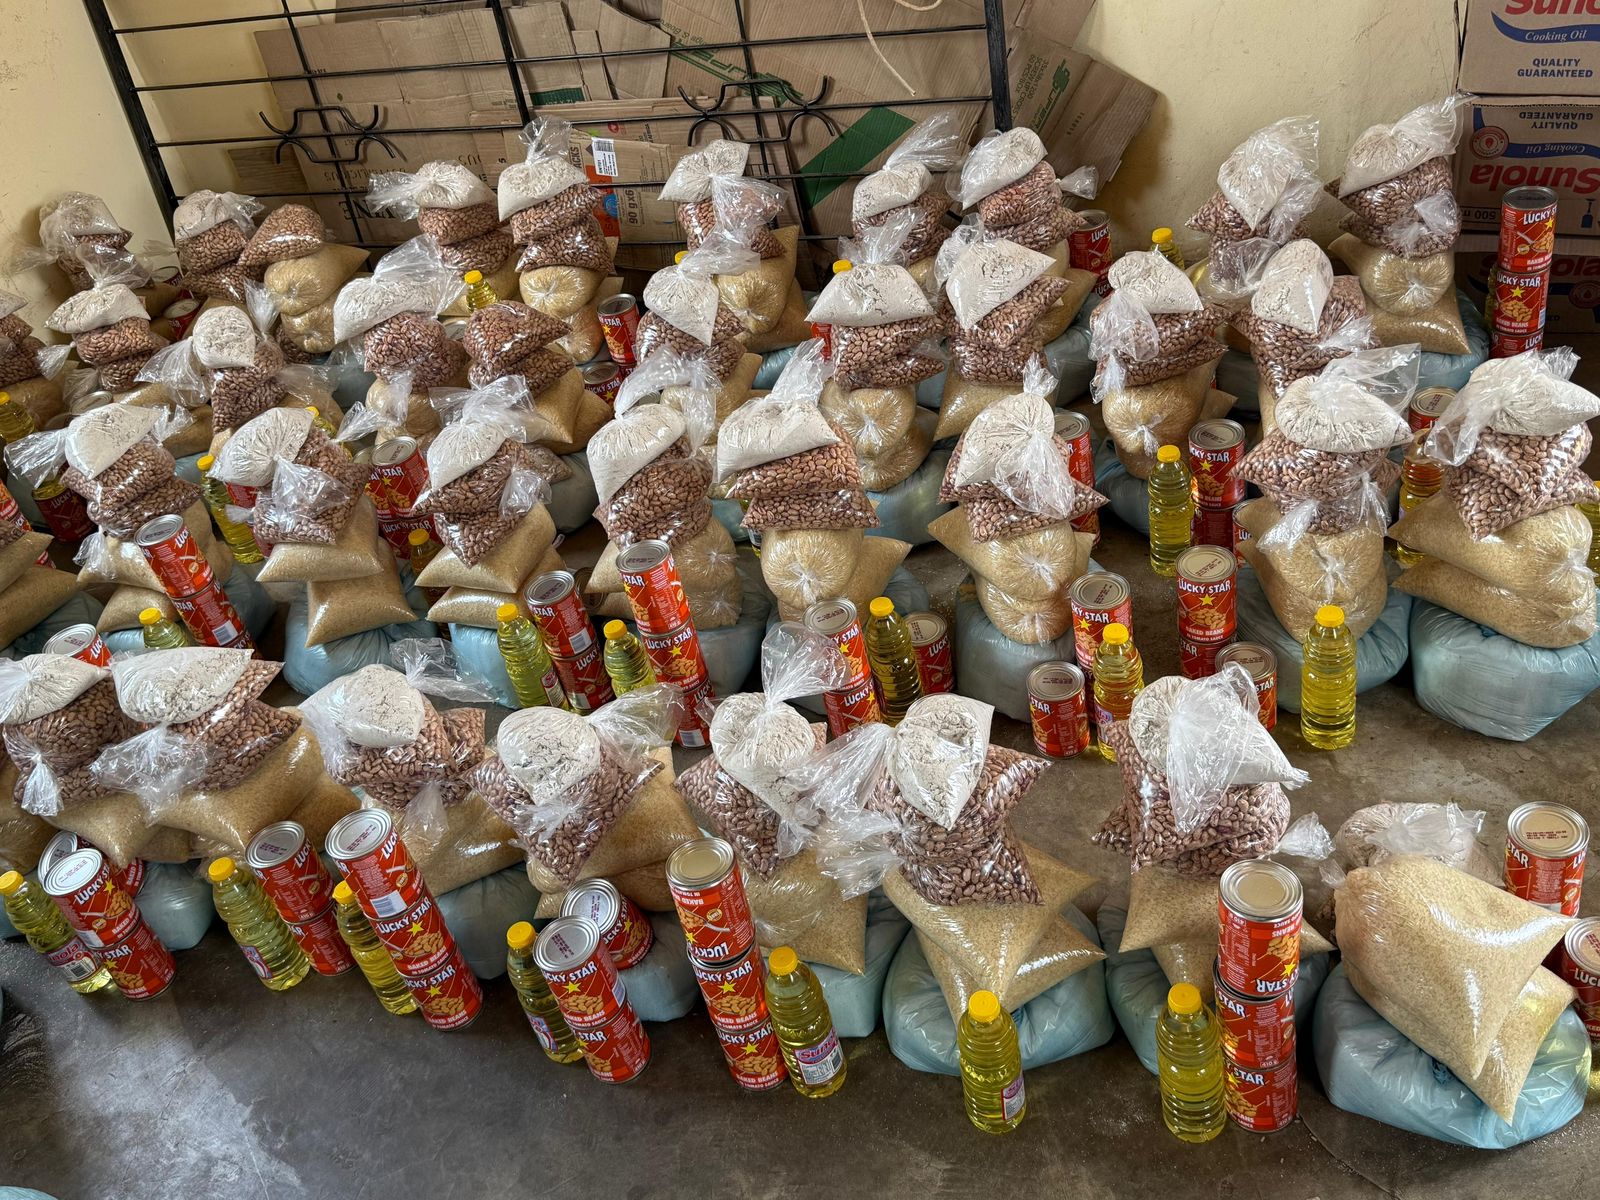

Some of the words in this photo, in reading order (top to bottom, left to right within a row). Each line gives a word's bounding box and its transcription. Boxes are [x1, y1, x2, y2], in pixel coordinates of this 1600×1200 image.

[1525, 32, 1567, 42] Cooking
[1570, 30, 1587, 40] Oil
[1533, 58, 1580, 67] QUALITY
[1517, 69, 1593, 78] GUARANTEED
[1519, 112, 1593, 121] GUARANTEED
[1531, 121, 1578, 130] QUALITY
[1526, 146, 1541, 154] Oil
[1545, 144, 1586, 153] Cooking
[570, 147, 582, 168] ACKS
[1470, 165, 1600, 194] Sunola
[1475, 210, 1496, 219] 500
[1523, 209, 1550, 225] LUCKY
[1520, 276, 1541, 287] STAR
[604, 318, 622, 327] STAR
[1207, 452, 1231, 463] STAR
[382, 466, 404, 476] STAR
[411, 521, 432, 530] STAR
[623, 576, 645, 587] STAR
[1178, 578, 1205, 594] LUCKY
[1208, 580, 1231, 592] STAR
[1085, 610, 1110, 623] STAR
[646, 638, 672, 650] LUCKY
[674, 629, 692, 645] STAR
[842, 624, 859, 642] STAR
[576, 650, 598, 671] LUCKY
[1255, 677, 1274, 692] STAR
[844, 687, 868, 707] LUCKY
[1030, 697, 1051, 714] STAR
[76, 878, 104, 905] LUCKY
[377, 916, 410, 934] LUCKY
[412, 898, 432, 922] STAR
[1271, 924, 1294, 936] BEANS
[104, 944, 133, 959] STAR
[695, 943, 729, 958] LUCKY
[429, 965, 456, 985] STAR
[570, 961, 598, 981] STAR
[696, 968, 722, 982] LUCKY
[725, 960, 753, 981] STAR
[1256, 979, 1286, 992] STAR
[1218, 993, 1245, 1017] STAR
[737, 1012, 758, 1024] BEANS
[578, 1030, 608, 1042] STAR
[718, 1029, 746, 1044] LUCKY
[748, 1023, 775, 1041] STAR
[758, 1071, 778, 1082] BEANS
[1233, 1069, 1264, 1085] STAR
